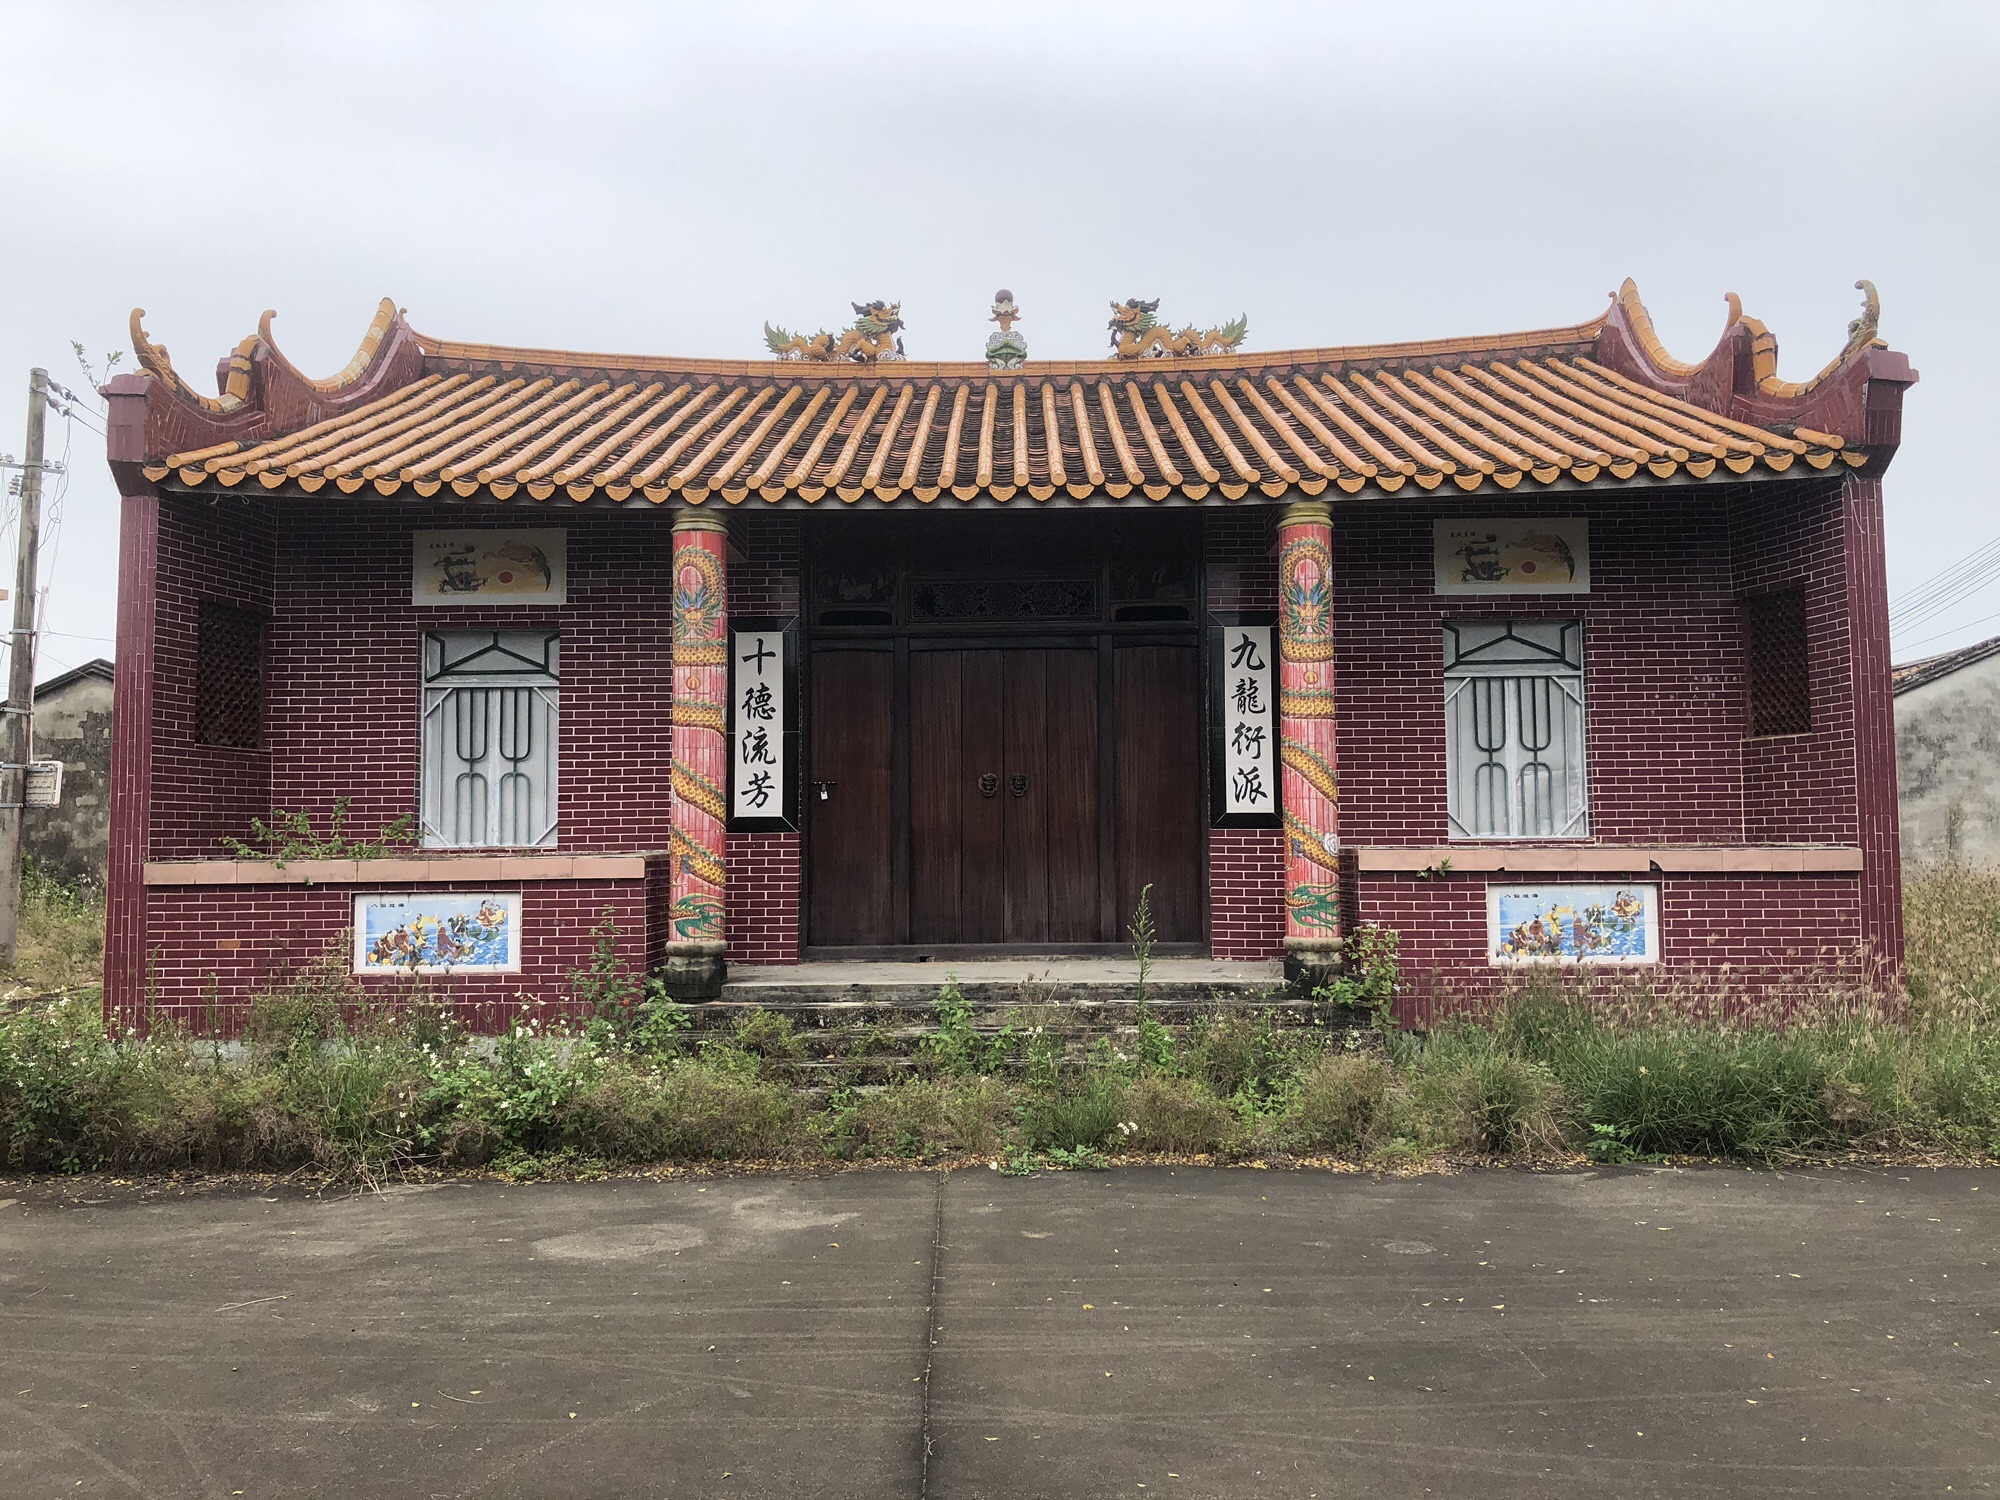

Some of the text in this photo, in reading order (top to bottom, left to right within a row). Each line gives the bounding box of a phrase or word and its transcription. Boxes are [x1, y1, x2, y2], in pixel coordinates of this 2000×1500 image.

[741, 638, 777, 809] 十德流芳
[1230, 632, 1268, 805] 九龍衍派
